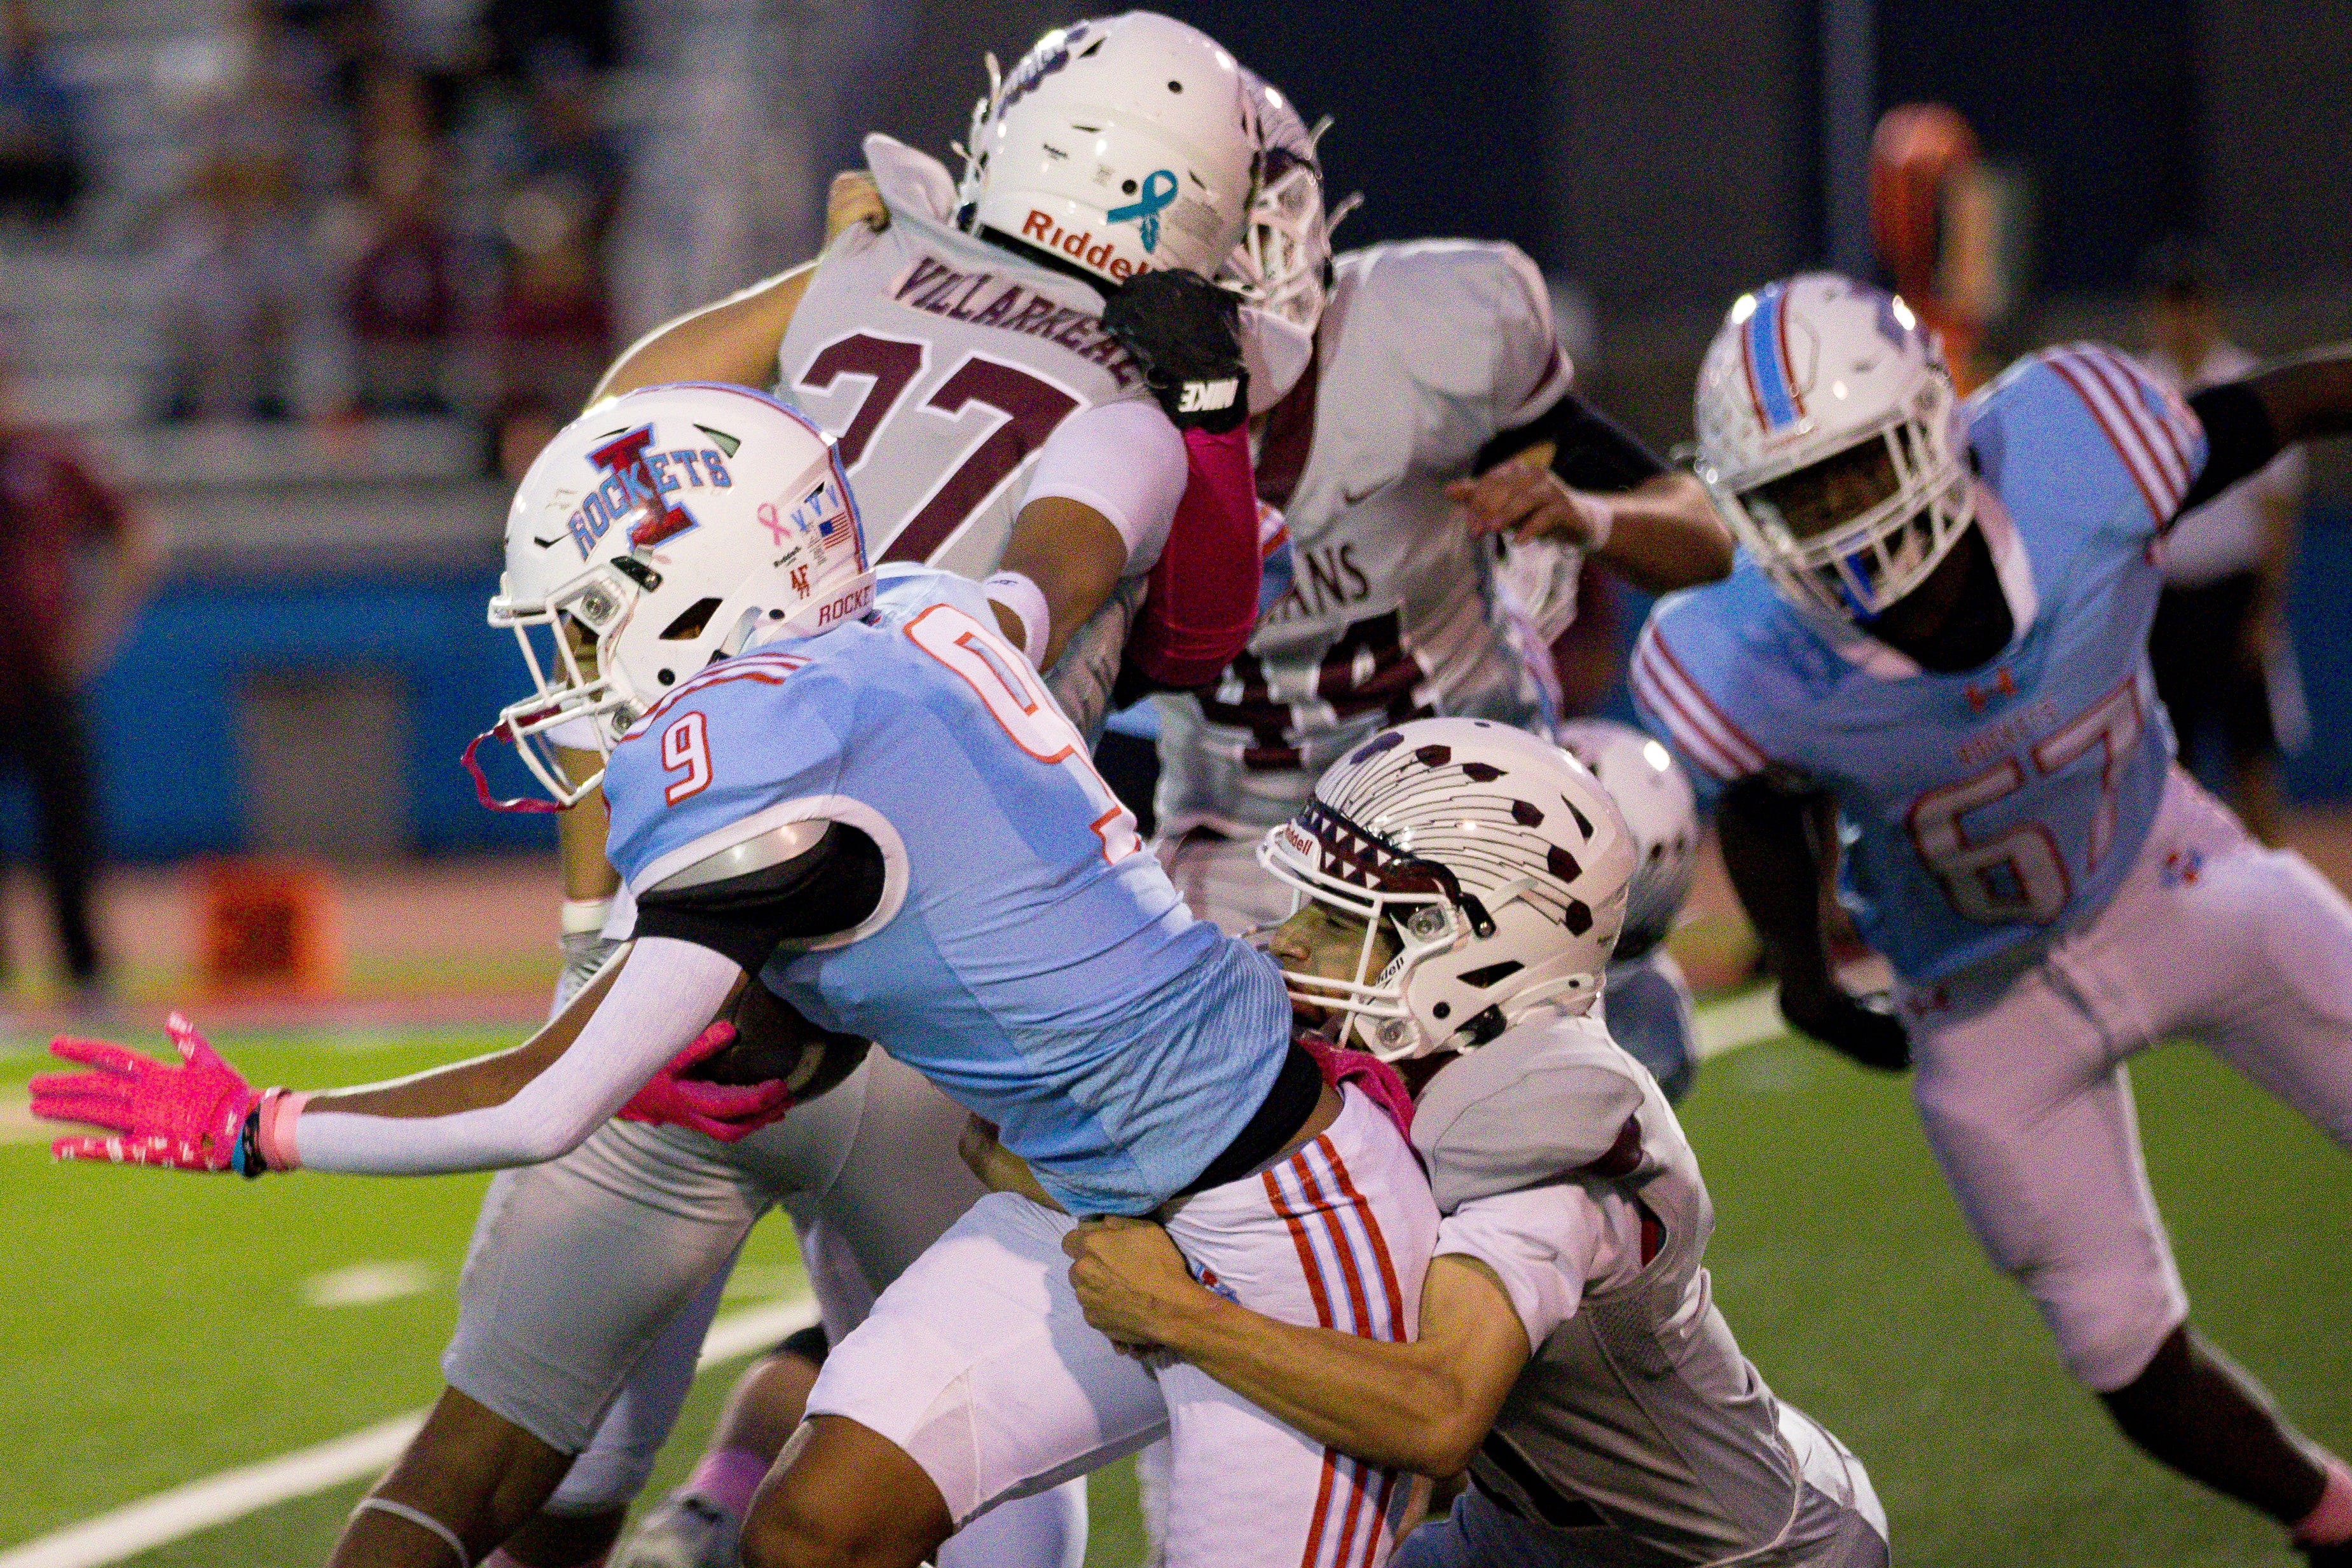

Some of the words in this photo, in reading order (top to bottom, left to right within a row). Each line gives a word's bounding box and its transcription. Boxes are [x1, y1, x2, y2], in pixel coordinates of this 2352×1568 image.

[567, 449, 732, 562] ROCKETS
[1265, 544, 1371, 620] ANS
[660, 710, 713, 808] 9
[1906, 671, 2145, 928] 67
